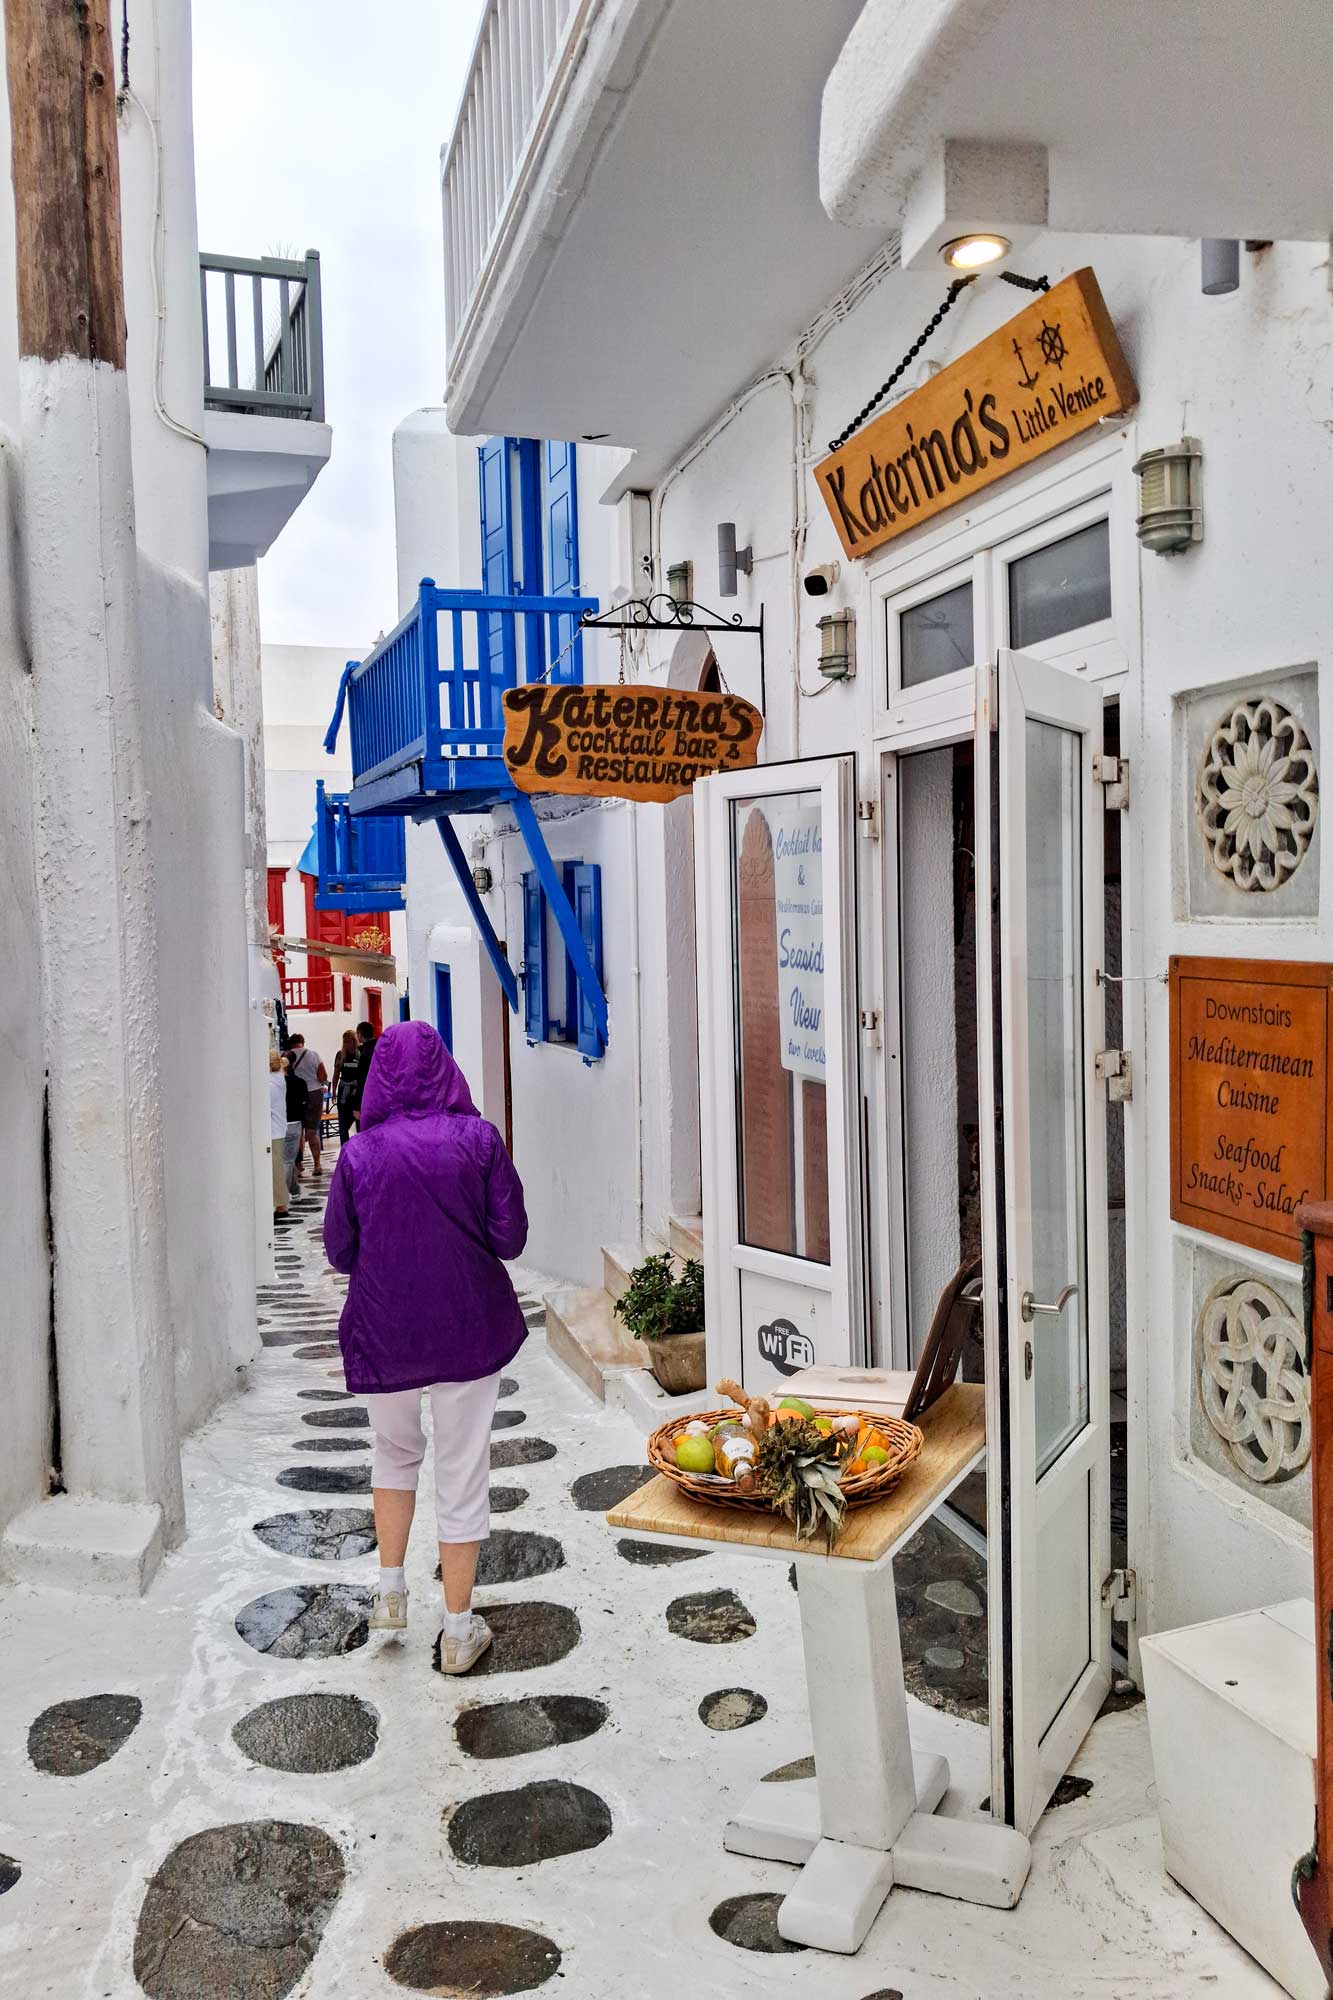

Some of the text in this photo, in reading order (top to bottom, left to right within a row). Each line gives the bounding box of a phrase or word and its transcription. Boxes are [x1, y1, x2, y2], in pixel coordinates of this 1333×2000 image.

[1012, 376, 1106, 444] Little Venice
[826, 388, 1011, 544] Katerina's
[790, 986, 821, 1031] View
[1206, 998, 1292, 1028] Downstairs
[788, 1038, 800, 1057] two
[1188, 1036, 1313, 1078] Mediterranean
[1217, 1080, 1279, 1115] Cuisine
[1214, 1135, 1285, 1173] Seafood
[774, 1326, 790, 1336] FREE
